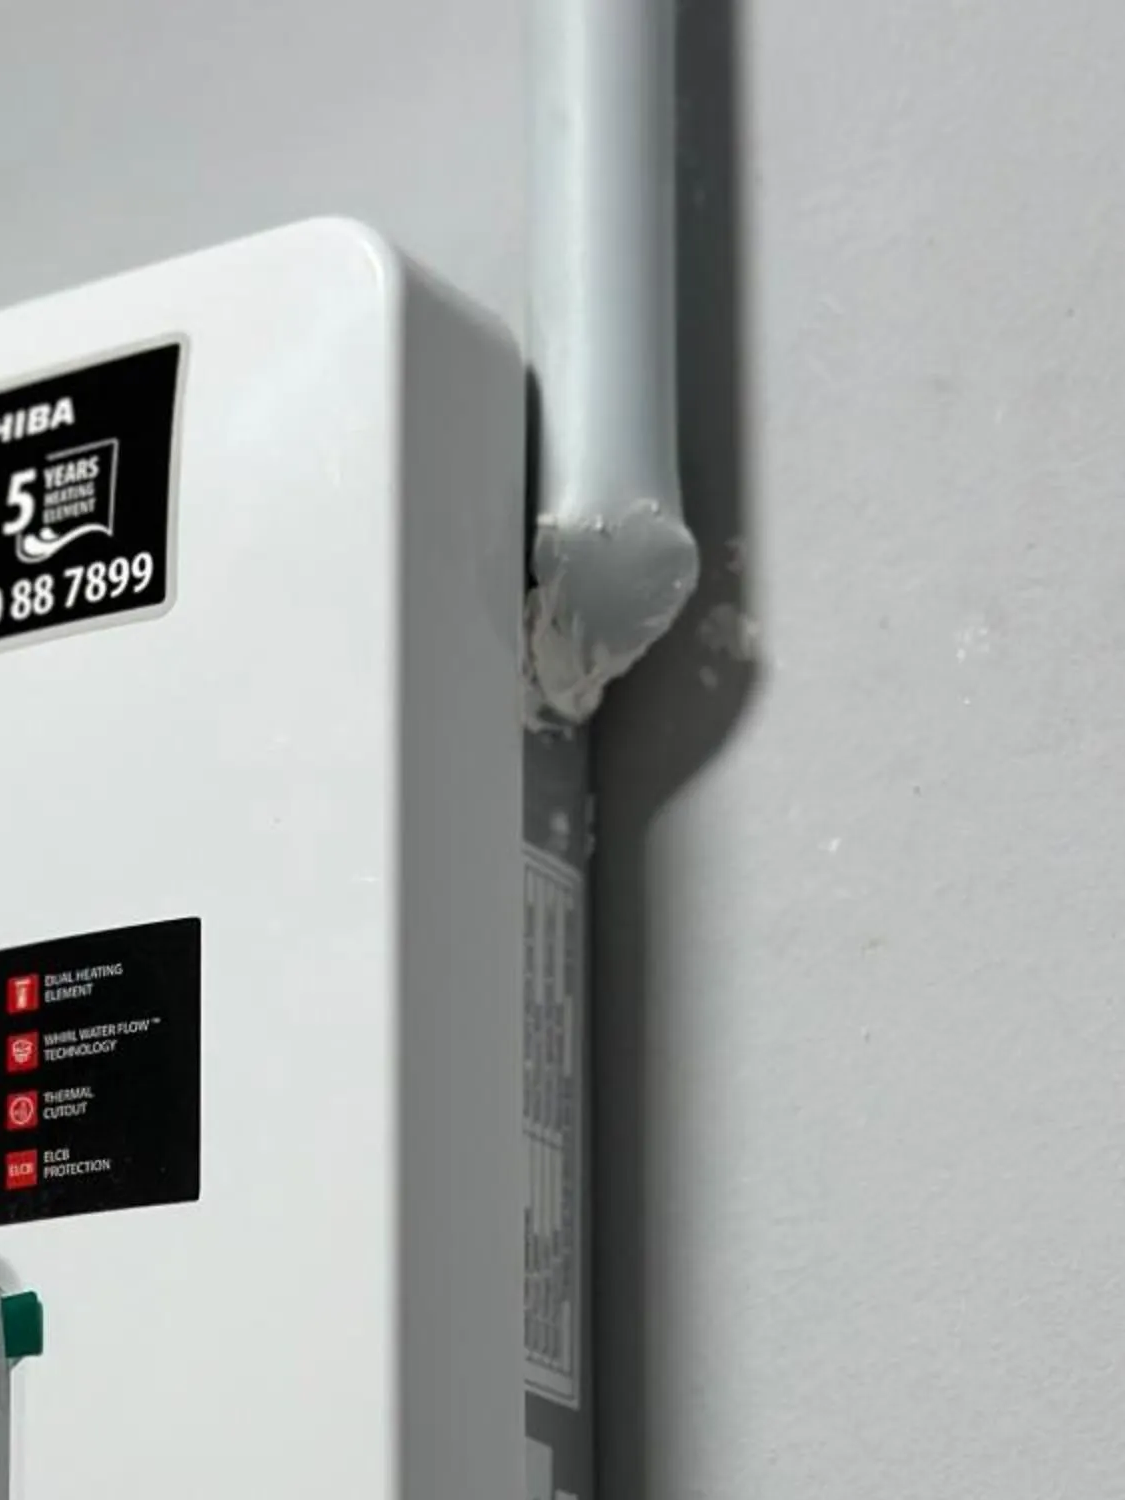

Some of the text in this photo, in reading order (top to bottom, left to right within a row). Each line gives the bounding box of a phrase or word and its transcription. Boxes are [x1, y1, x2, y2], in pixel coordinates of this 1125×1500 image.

[1, 455, 99, 535] 5 YEARS
[44, 481, 96, 507] HEATING
[43, 498, 96, 525] ELEMENT
[10, 574, 54, 620] 88
[63, 551, 154, 608] 7899
[44, 963, 123, 987] DUAL HEATING
[44, 983, 94, 1003] ELEMENT
[78, 1023, 115, 1042] WATER
[43, 1039, 117, 1062] TECHNOLOGY
[43, 1086, 94, 1105] THERMAL
[43, 1102, 88, 1120] CUTOUT
[43, 1148, 70, 1163] ELCB
[43, 1159, 111, 1180] PROTECTION
